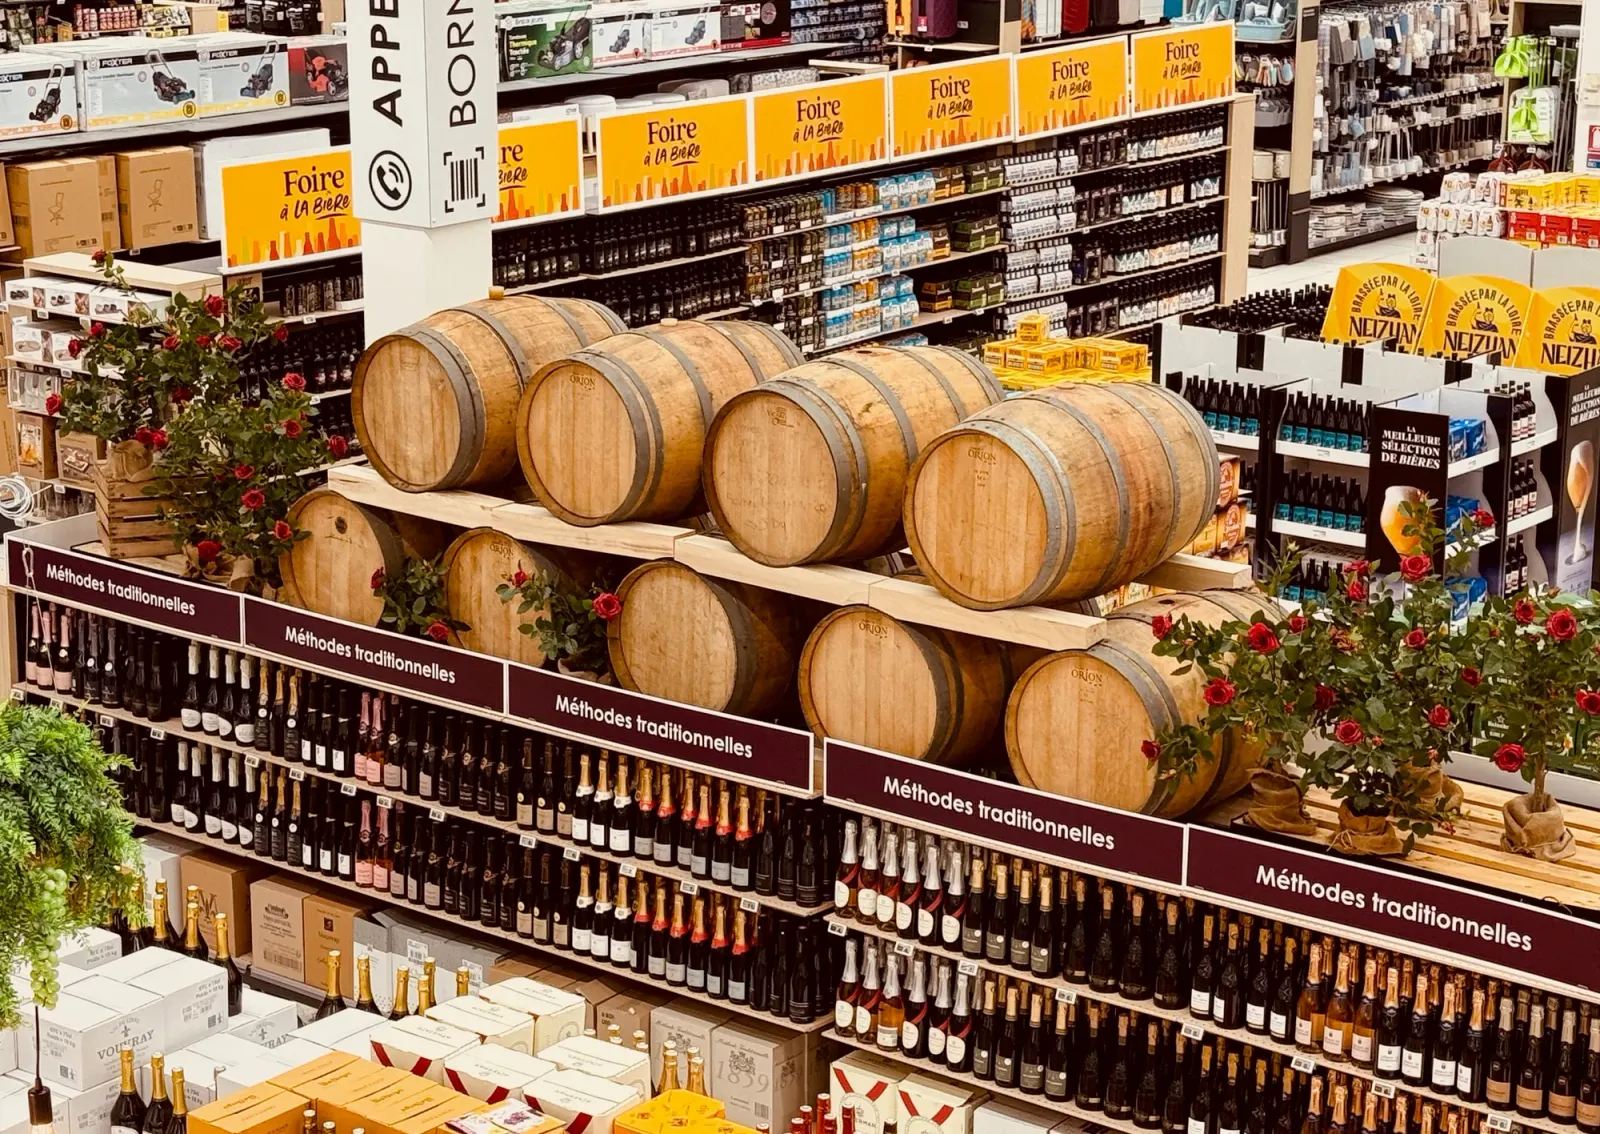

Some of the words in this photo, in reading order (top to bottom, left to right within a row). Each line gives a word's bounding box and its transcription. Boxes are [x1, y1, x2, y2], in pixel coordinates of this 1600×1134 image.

[211, 50, 239, 60] FOXTER
[1165, 38, 1200, 62] Foire
[102, 57, 133, 68] FOXTER
[369, 0, 402, 128] APPE
[1052, 57, 1090, 82] Foire
[930, 75, 971, 100] Foire
[796, 95, 841, 122] Foire
[936, 102, 946, 119] LA
[647, 117, 698, 145] Foire
[793, 128, 800, 143] à
[803, 124, 814, 142] LA
[643, 151, 651, 167] à
[655, 148, 667, 165] LA
[283, 165, 345, 197] Foire
[280, 204, 289, 221] à
[294, 199, 309, 219] LA
[1400, 281, 1410, 295] LA
[1498, 294, 1510, 308] LA
[1506, 305, 1522, 336] LOIRE
[1541, 343, 1600, 370] NEIZH
[569, 374, 595, 386] ORION
[1381, 439, 1441, 457] SÉLECTION
[1382, 429, 1441, 446] MEILLEURE
[968, 449, 996, 461] ORION
[1381, 451, 1398, 464] DE
[1399, 454, 1441, 470] BIÈRES
[46, 563, 105, 594] Méthodes
[107, 579, 196, 617] traditionnelles
[859, 620, 888, 635] ORION
[285, 625, 352, 659] Méthodes
[354, 643, 457, 685] traditionnelles
[1071, 668, 1103, 683] ORION
[555, 694, 632, 729] Méthodes
[636, 714, 753, 759] traditionnelles
[883, 775, 973, 816] Méthodes
[978, 800, 1115, 850] traditionnelles
[1255, 864, 1366, 910] Méthodes
[1371, 892, 1533, 952] traditionnelles
